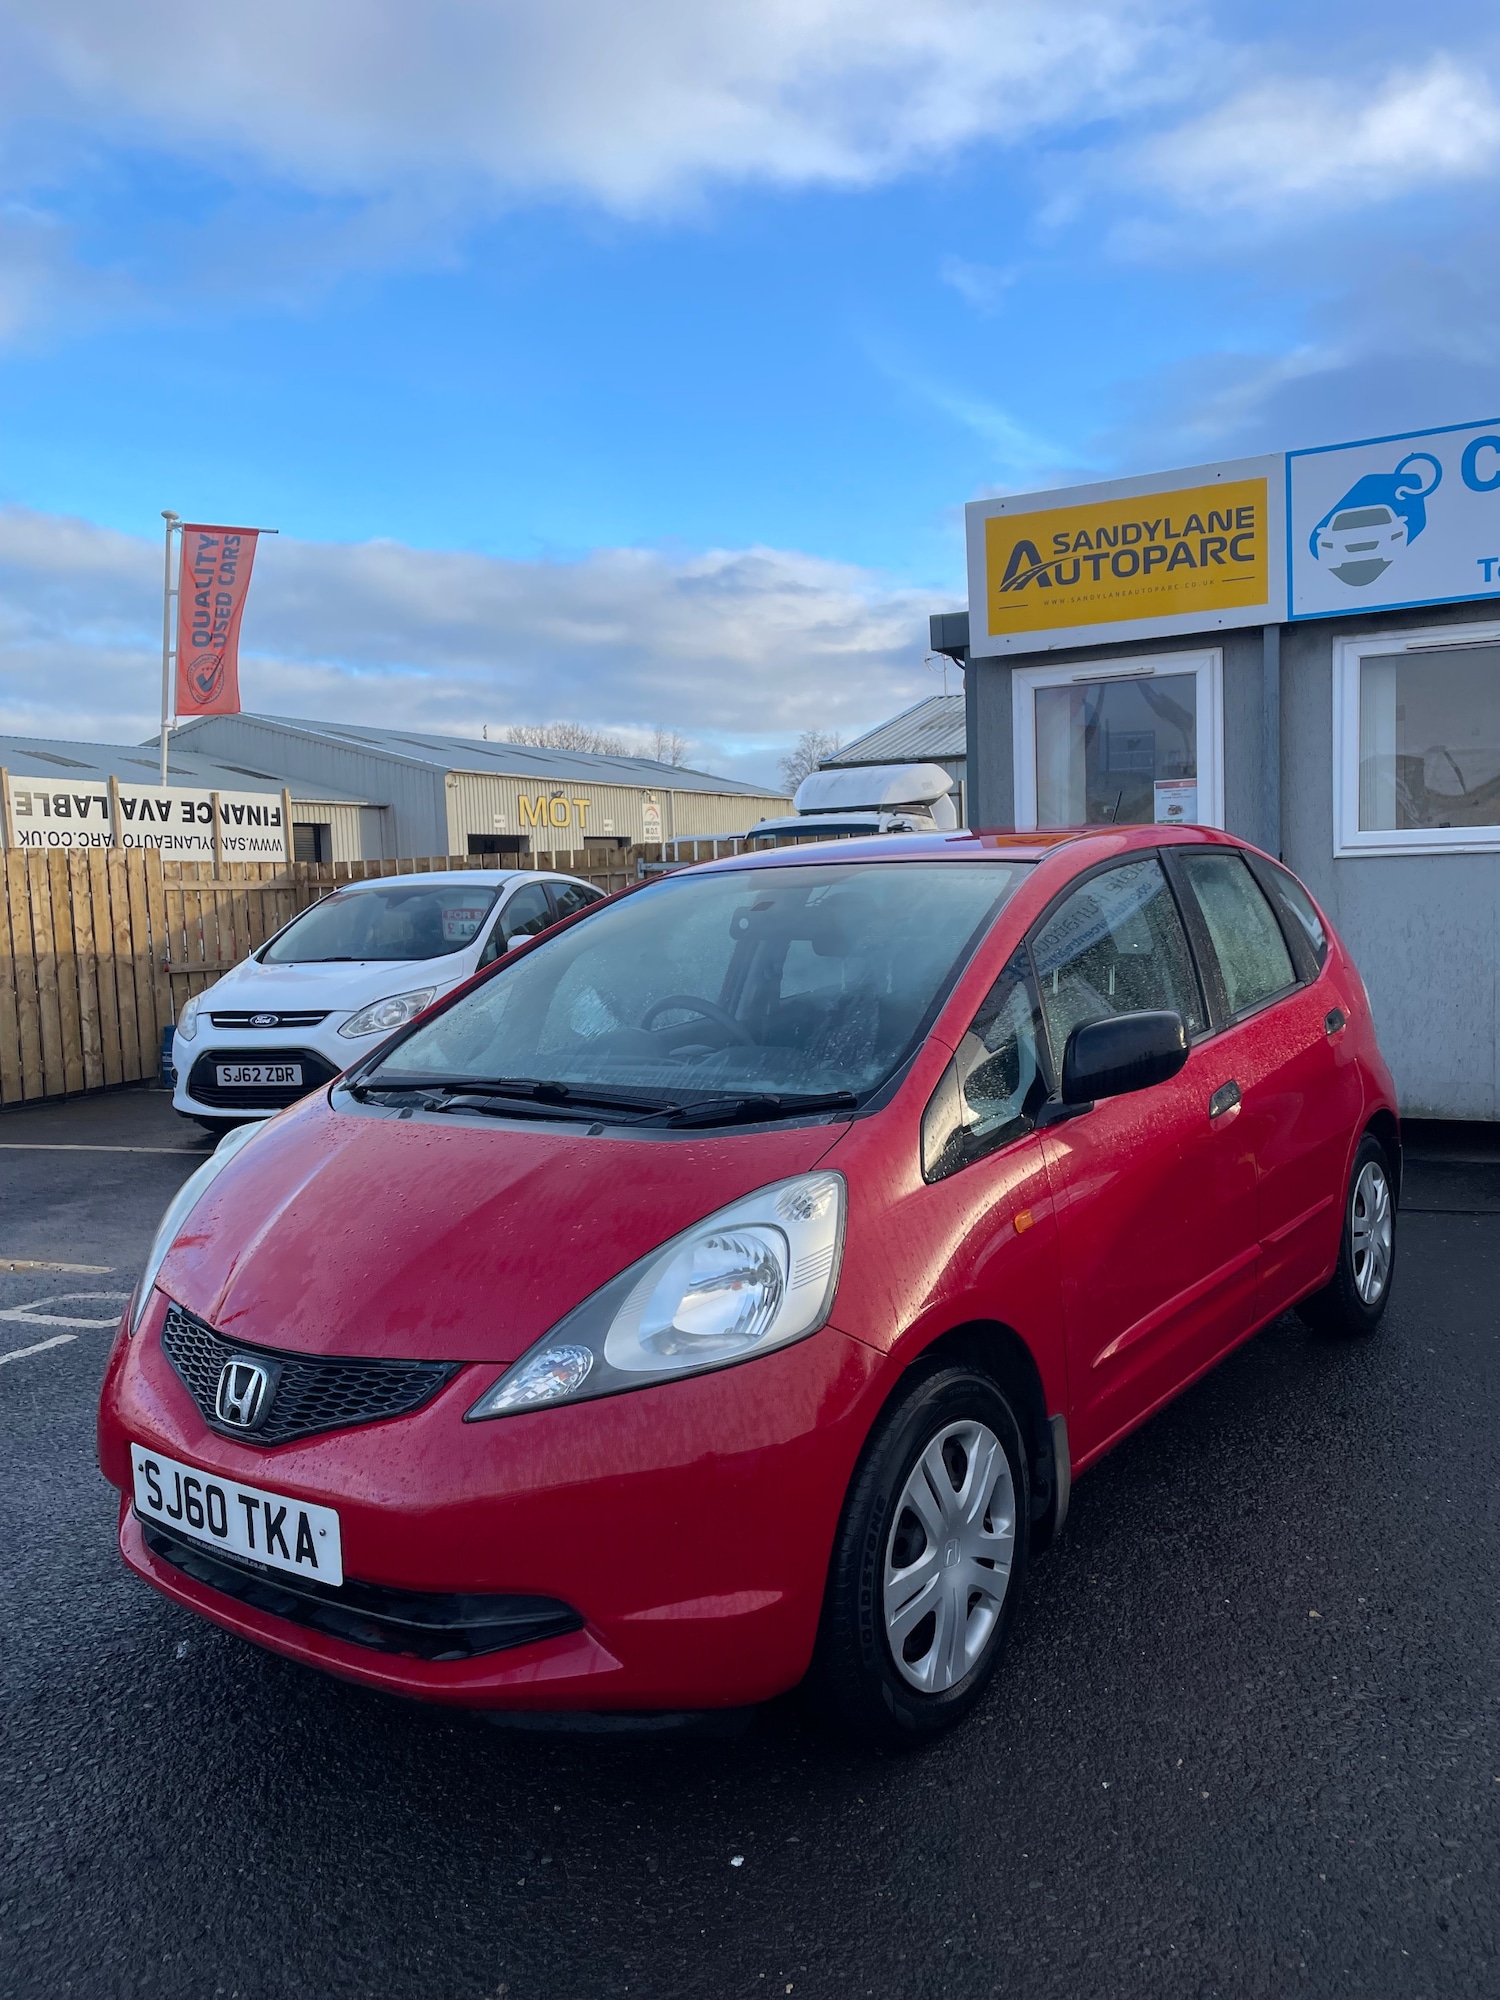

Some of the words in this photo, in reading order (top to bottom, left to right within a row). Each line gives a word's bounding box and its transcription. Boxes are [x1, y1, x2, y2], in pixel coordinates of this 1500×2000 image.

[1053, 505, 1255, 555] SANDYLANE
[218, 534, 242, 586] CARS
[998, 531, 1255, 593] AUTOPARC
[1477, 556, 1500, 582] T
[191, 533, 219, 648] QUALITY
[1043, 579, 1216, 606] WWW.SANDYLANEAUTOPARC.CO.UK
[213, 591, 233, 649] USED
[14, 791, 172, 822] AVALABLE
[182, 801, 282, 827] FINANCE
[518, 794, 591, 828] MOT
[17, 829, 283, 852] WWW.SANDYLANEAUTOARC.CO.UK
[447, 910, 471, 919] FOR
[254, 1015, 272, 1025] Ford
[223, 1067, 262, 1082] SJ62
[144, 1459, 229, 1538] SJ60
[237, 1493, 319, 1568] TKA
